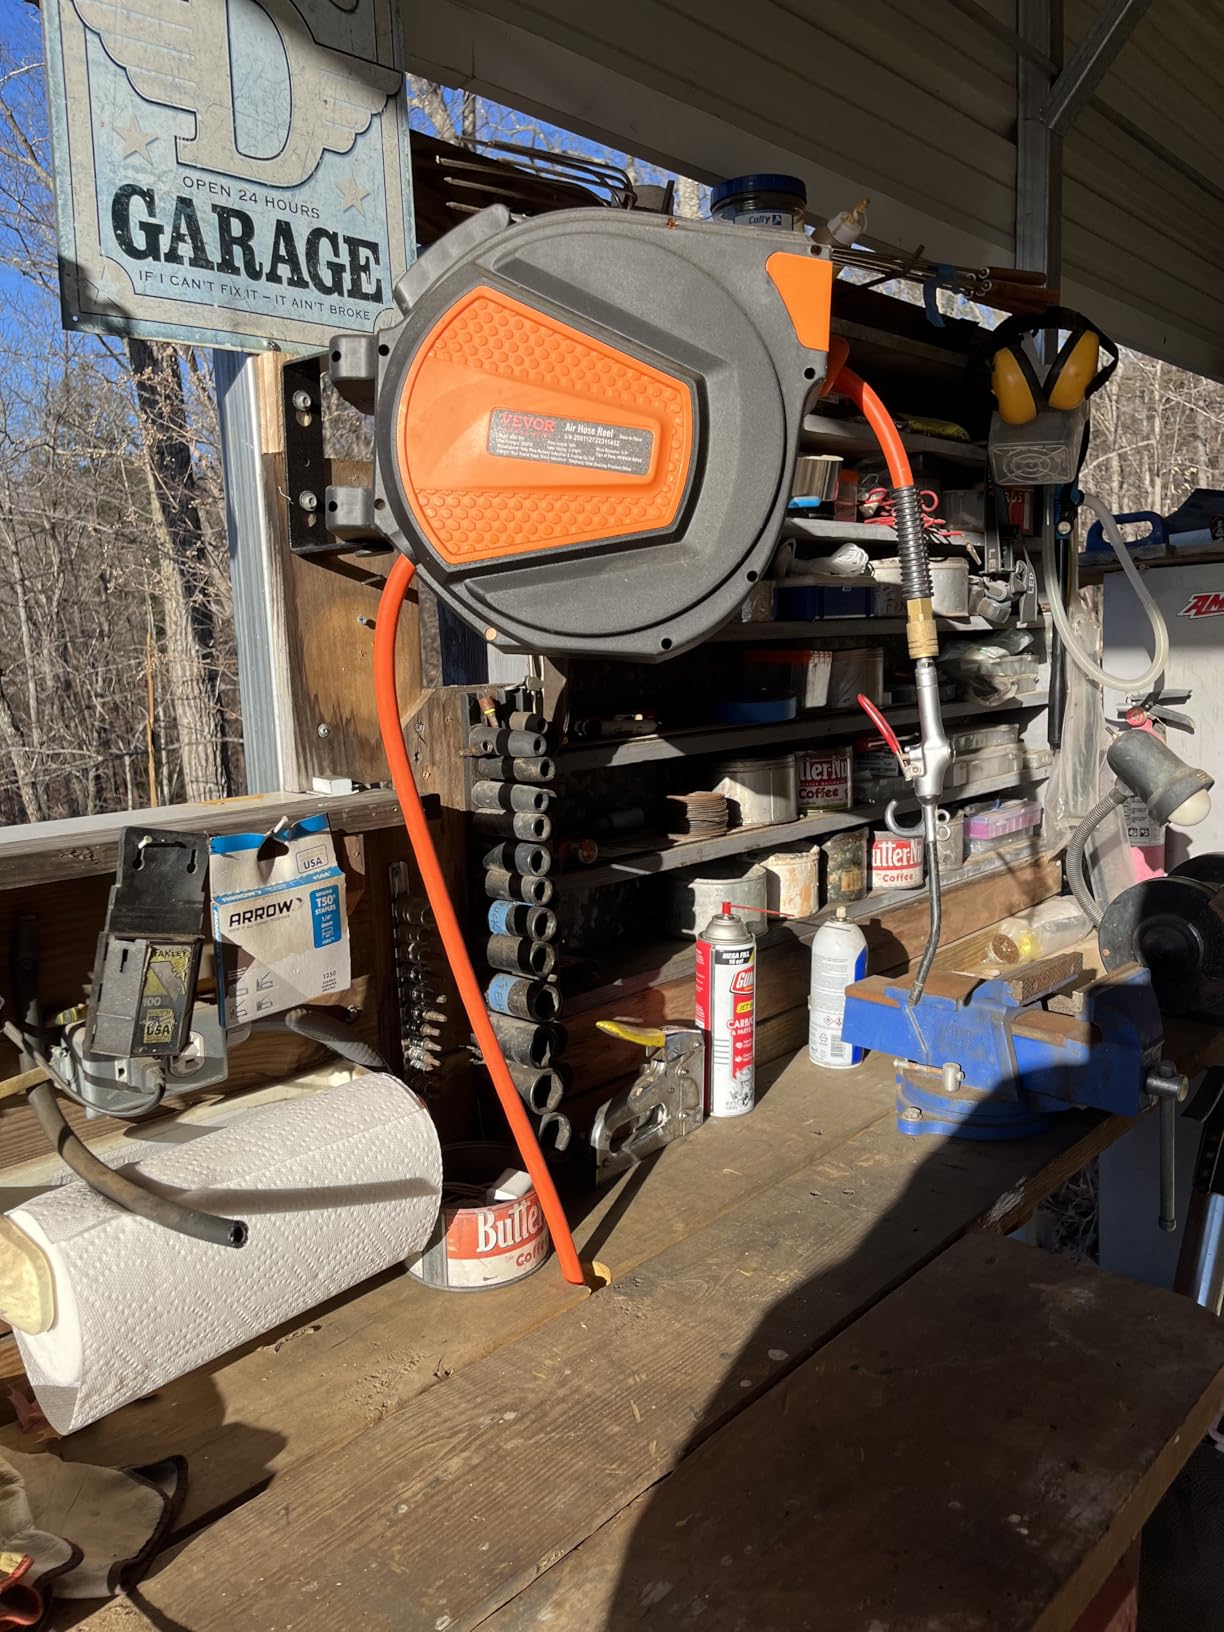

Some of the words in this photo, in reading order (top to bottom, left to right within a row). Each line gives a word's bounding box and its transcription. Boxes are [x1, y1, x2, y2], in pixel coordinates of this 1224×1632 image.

[183, 175, 232, 200] OPEN
[238, 188, 260, 205] 24
[264, 195, 321, 220] HOURS
[110, 184, 384, 304] GARAGE
[139, 270, 153, 281] IF
[170, 275, 215, 291] CAN'T
[221, 284, 241, 297] FIX
[246, 288, 258, 300] IT
[275, 294, 286, 305] IT
[292, 298, 324, 312] AIN'T
[329, 304, 371, 320] BROKE
[500, 411, 555, 432] VEVOR
[564, 423, 577, 432] Air
[577, 425, 596, 437] Hose
[597, 428, 614, 439] Reel
[799, 787, 839, 799] Coffee
[303, 857, 322, 870] USA
[882, 872, 914, 883] Coffee
[229, 899, 295, 927] ARROW
[323, 970, 337, 979] 1250
[146, 1025, 170, 1036] USA
